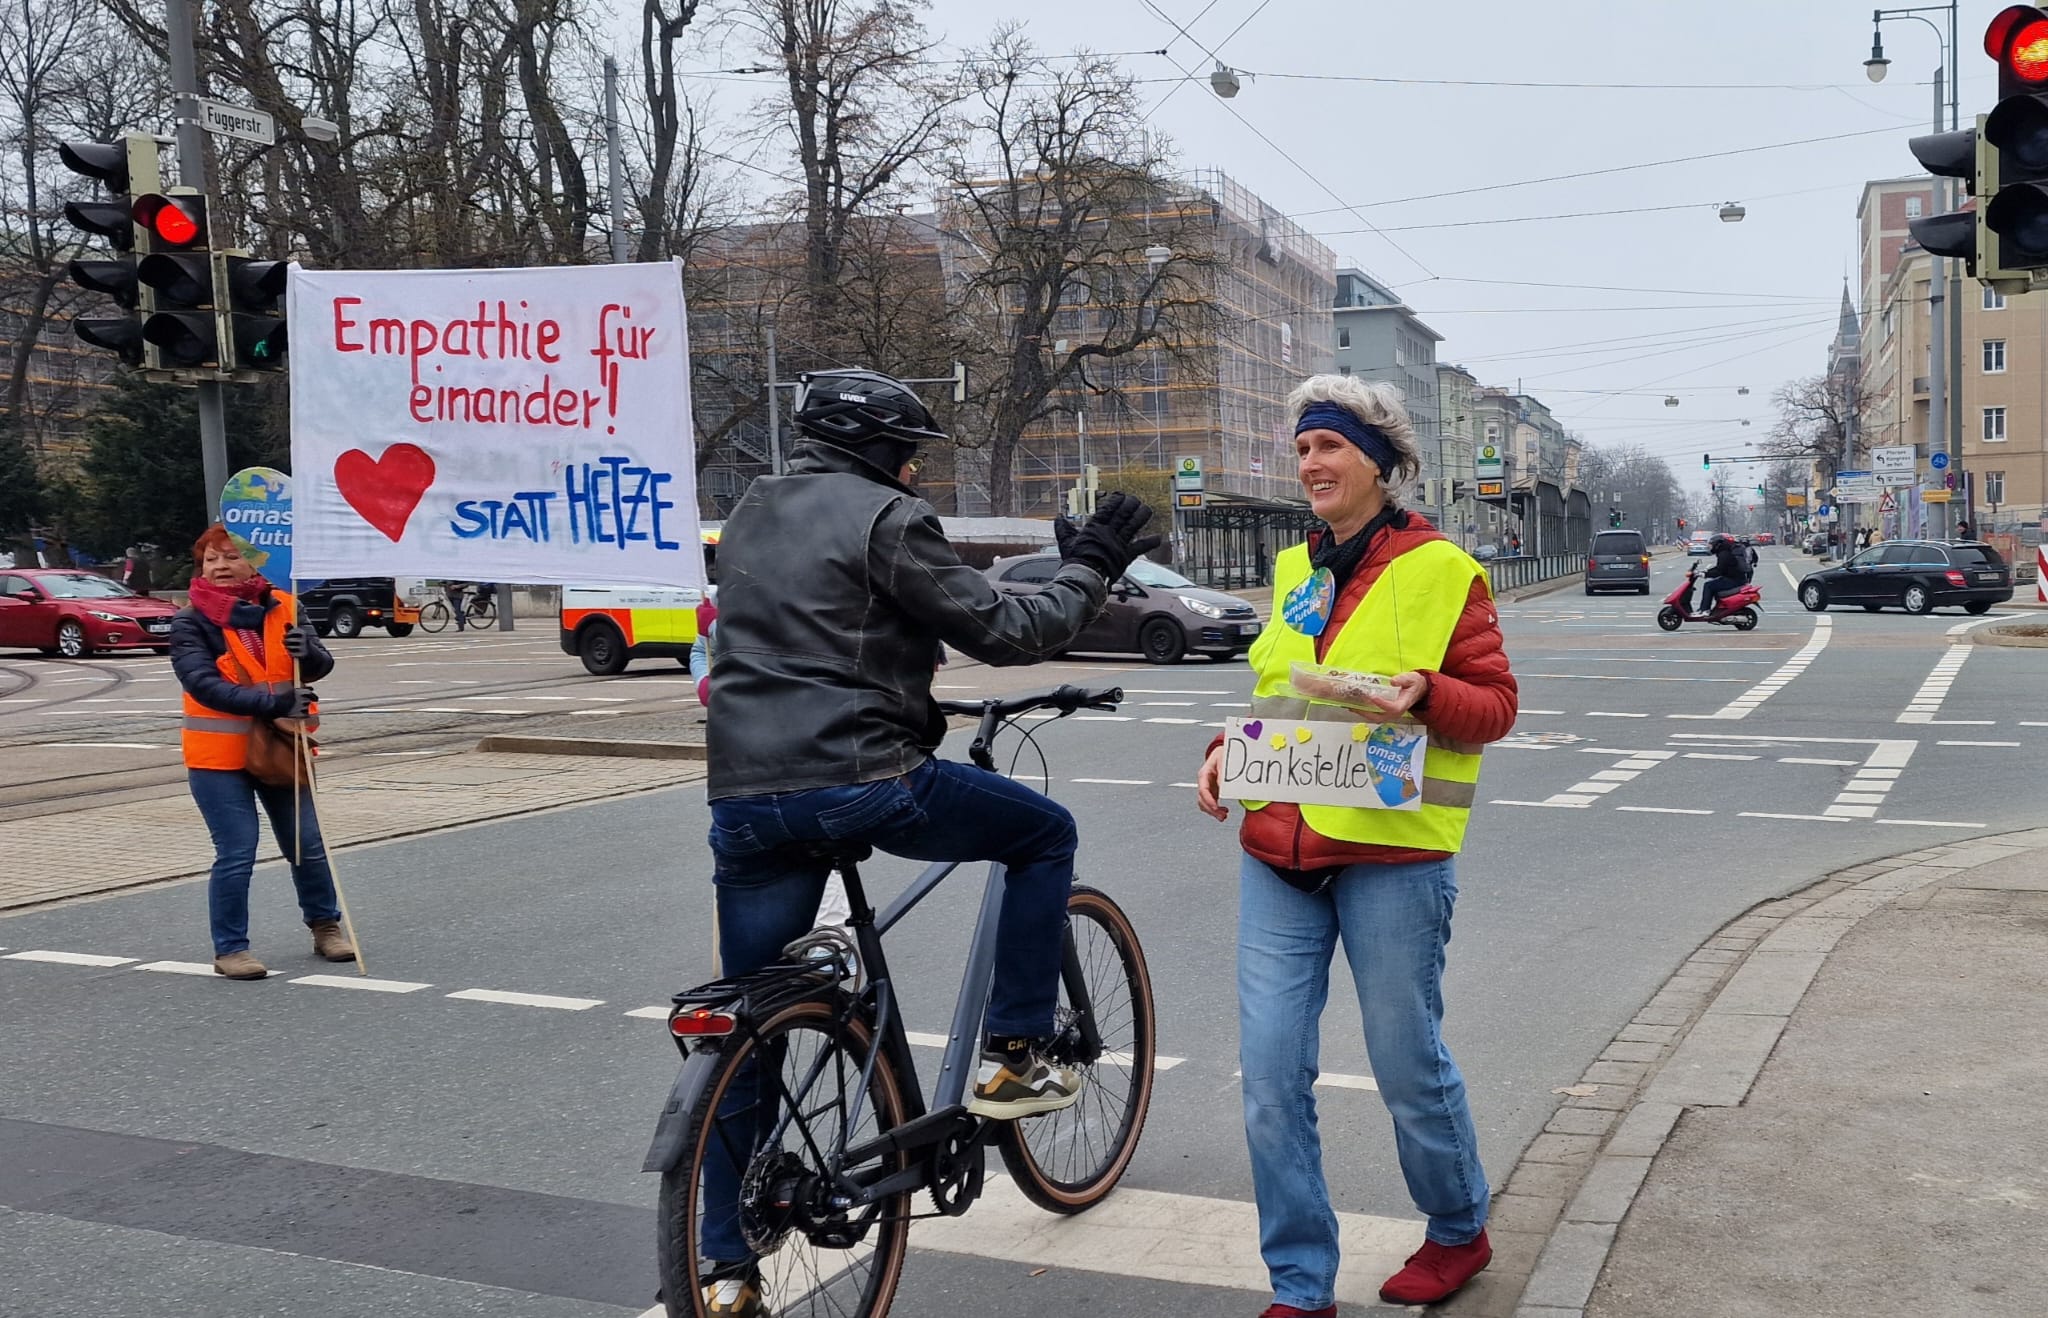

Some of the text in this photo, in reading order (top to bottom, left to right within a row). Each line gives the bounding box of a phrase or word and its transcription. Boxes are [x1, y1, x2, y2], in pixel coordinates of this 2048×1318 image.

[207, 106, 266, 135] Fuggerstr.
[333, 297, 656, 386] Empathie für
[409, 361, 620, 435] einander!
[839, 392, 867, 404] uvex
[449, 455, 682, 552] STATT HETZE
[225, 507, 292, 525] omas
[249, 527, 292, 546] futu
[1283, 597, 1310, 620] omas
[1294, 600, 1321, 624] future
[1224, 736, 1369, 789] Dankstelle
[1368, 745, 1405, 763] omas
[1375, 759, 1413, 781] future
